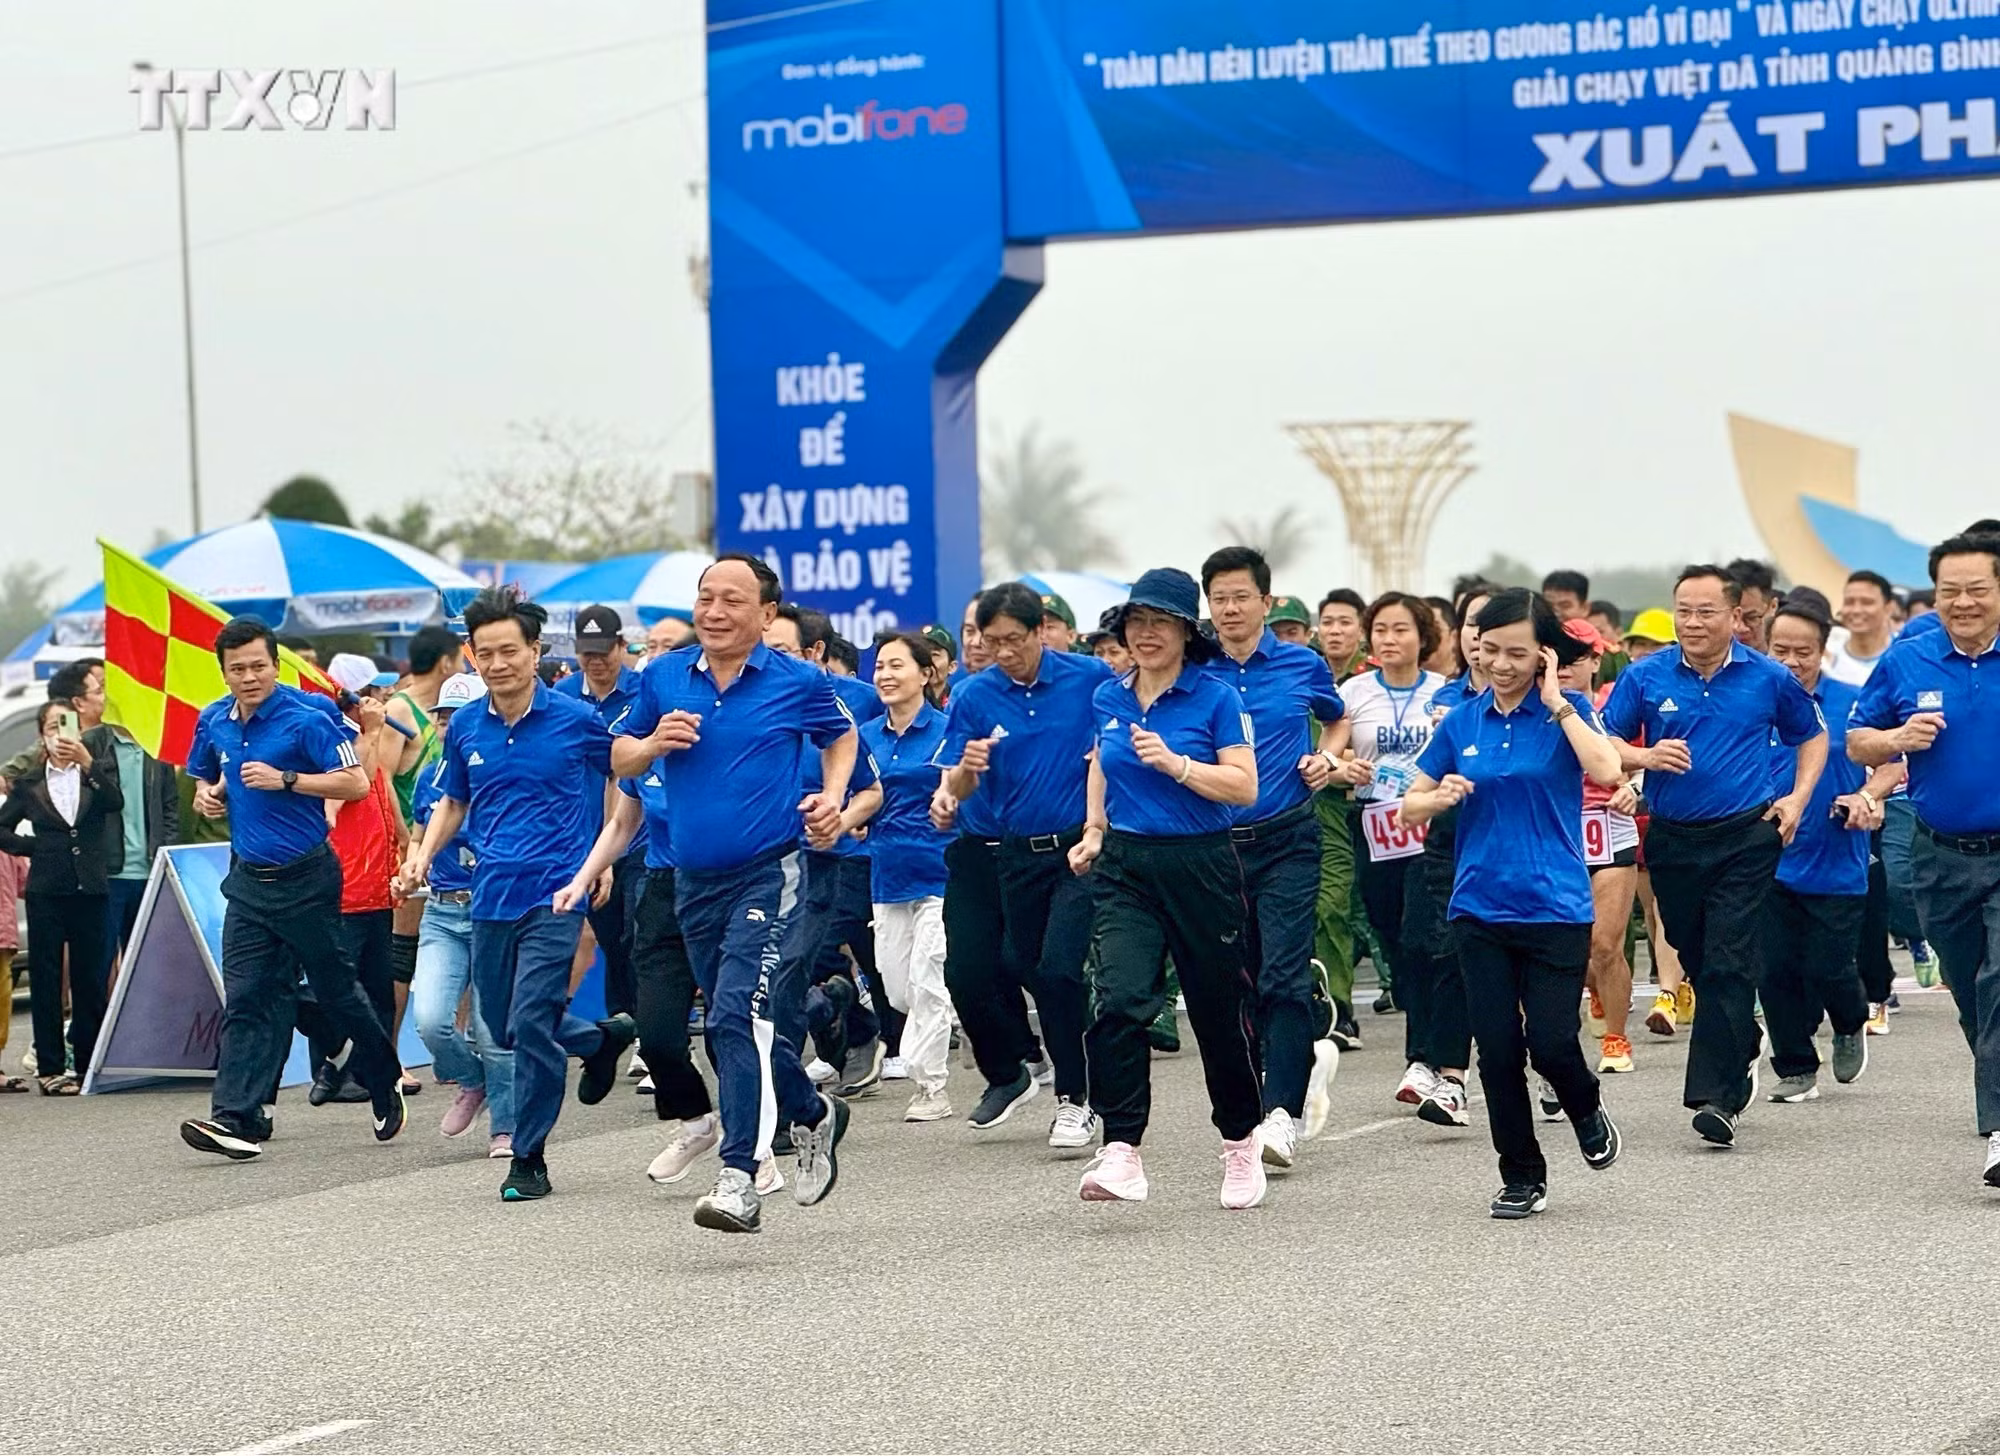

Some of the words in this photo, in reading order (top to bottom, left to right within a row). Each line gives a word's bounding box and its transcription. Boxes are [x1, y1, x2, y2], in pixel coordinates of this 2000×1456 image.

[1257, 38, 1326, 83] LUYỆN
[1328, 33, 1387, 74] THÂN
[1434, 29, 1491, 65] THEO
[1495, 21, 1572, 60] GƯƠNG
[1575, 13, 1623, 54] BÁC
[1755, 0, 1788, 37] VÀ
[1860, 0, 1920, 31] CHẠY
[1513, 67, 1570, 108] GIẢI
[1574, 68, 1648, 107] CHẠY
[1653, 59, 1713, 101] VIỆT
[1718, 54, 1758, 92] DÃ
[1763, 47, 1830, 87] TỈNH
[1836, 38, 1934, 84] QUẢNG
[742, 99, 968, 151] mobifone
[1529, 101, 1825, 192] XUẤT
[1857, 98, 2000, 167] PH
[776, 352, 866, 406] KHỎE
[799, 411, 847, 467] ĐỂ
[739, 483, 807, 532] XÂY
[814, 483, 909, 535] DỰNG
[792, 538, 862, 592] BẢO
[868, 539, 913, 596] VỆ
[1377, 726, 1428, 744] BHXH
[1378, 743, 1423, 755] RUNNER
